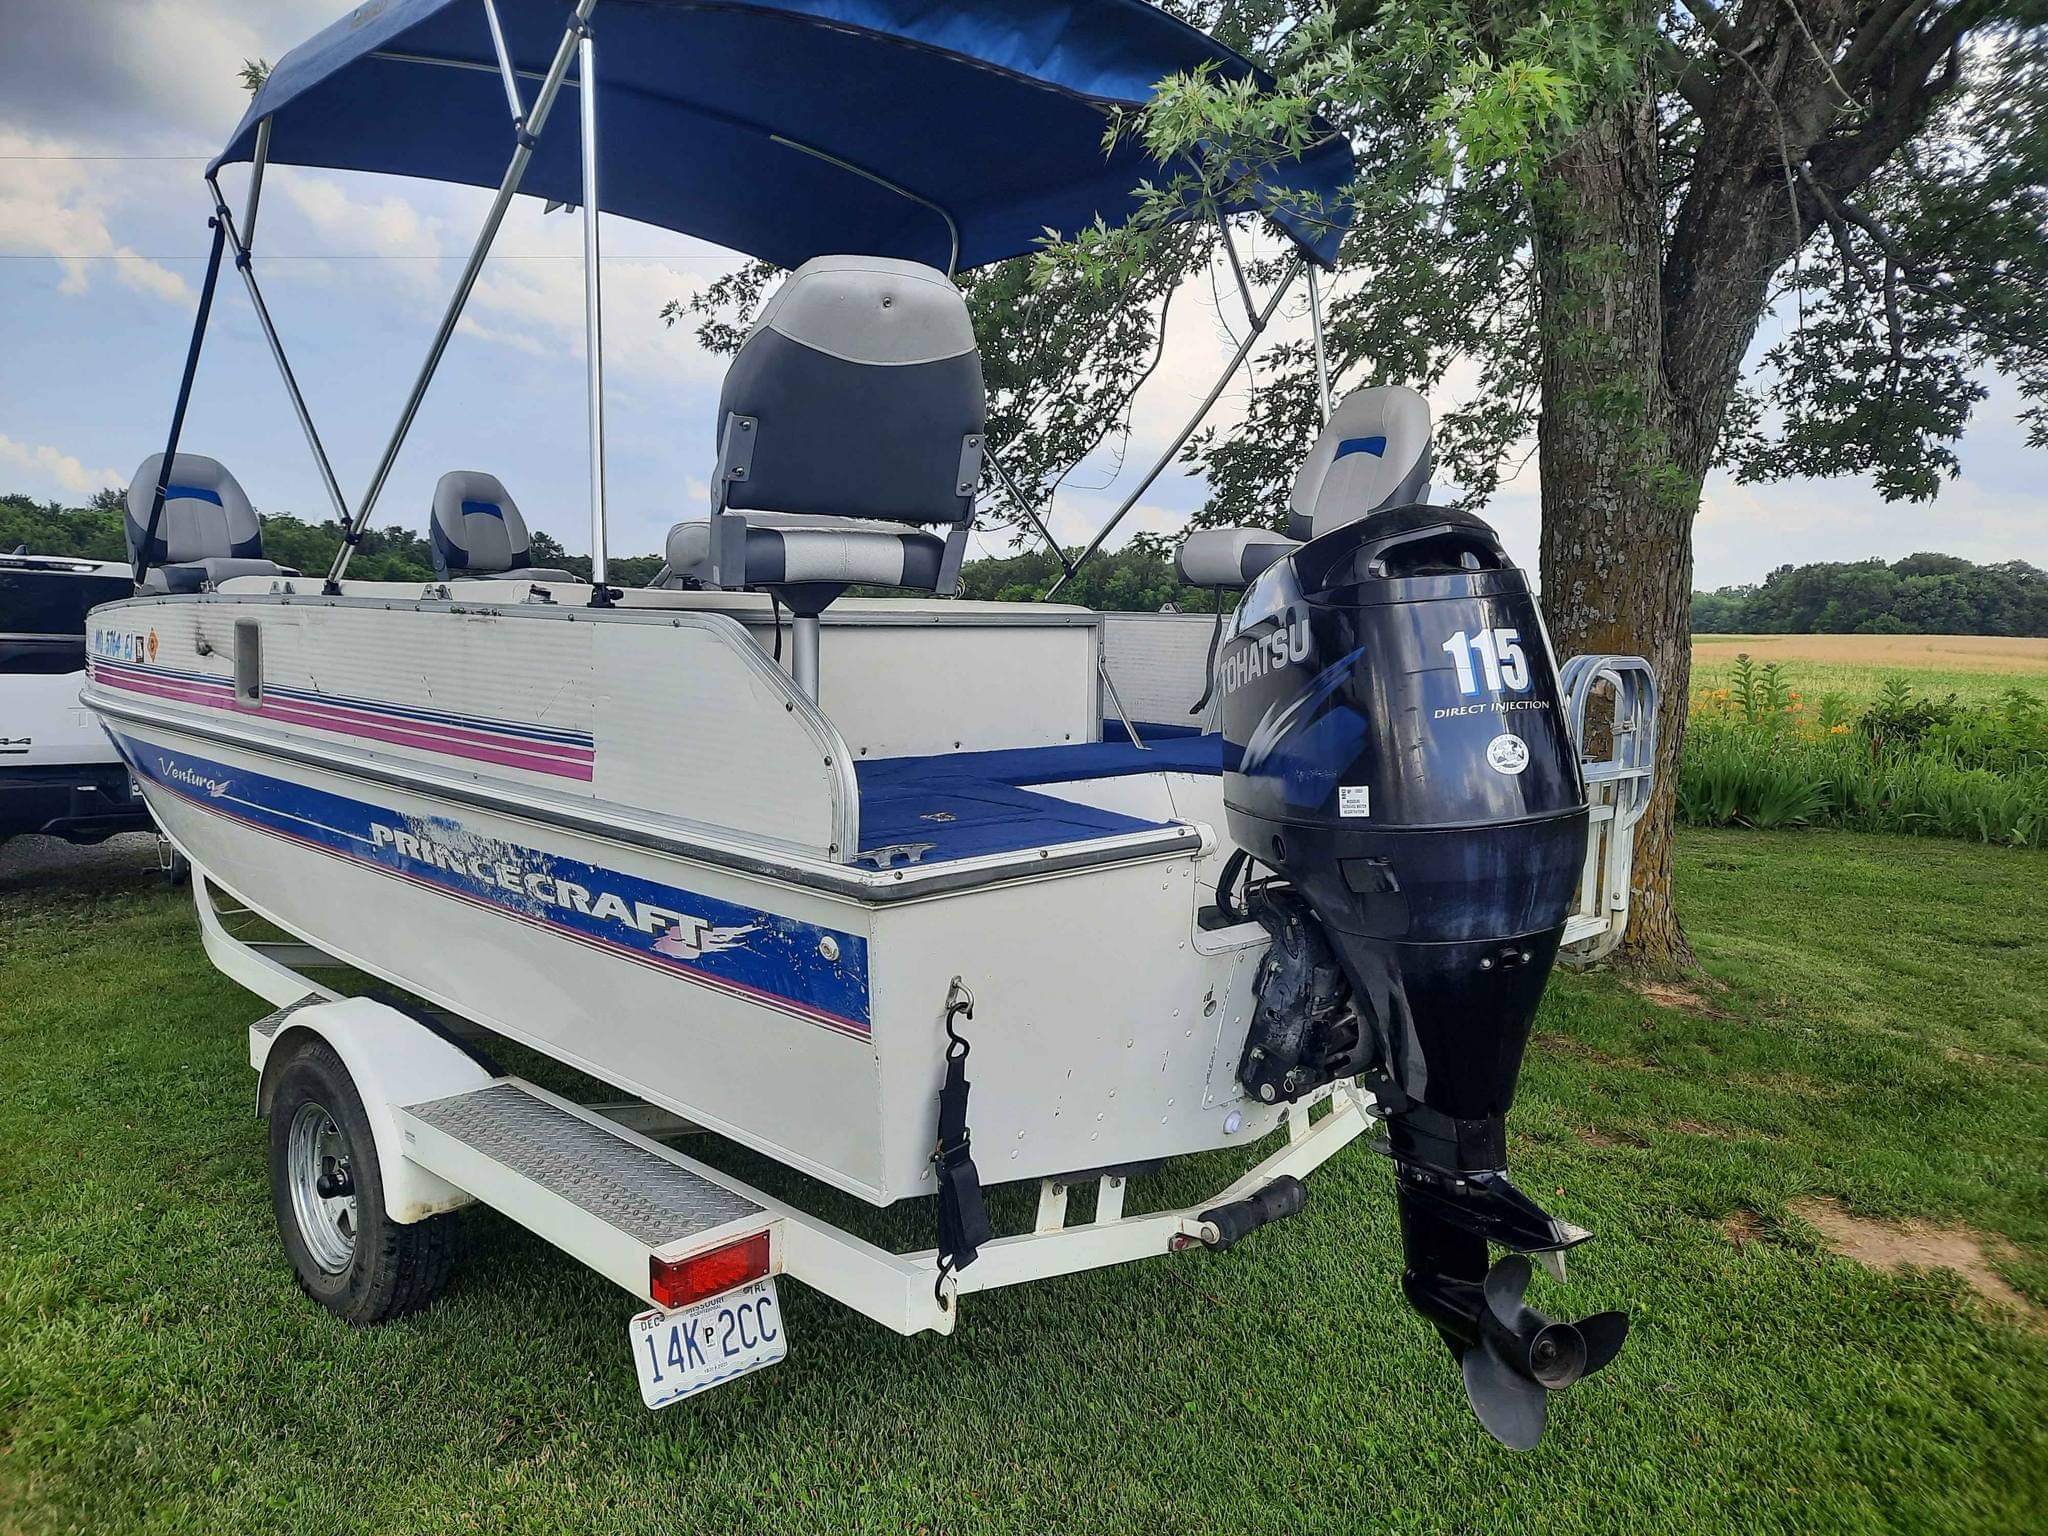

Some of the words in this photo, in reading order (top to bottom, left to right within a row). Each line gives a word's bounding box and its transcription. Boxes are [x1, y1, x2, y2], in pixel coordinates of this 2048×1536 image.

[1221, 619, 1311, 697] TOHATSU
[1442, 627, 1532, 696] 115
[1434, 704, 1487, 719] DIRECT
[1491, 699, 1550, 714] INJECTION
[158, 757, 216, 792] Ventura
[369, 822, 711, 949] PRINCECRAFT
[640, 1317, 660, 1331] DEC
[645, 1318, 706, 1383] 14K
[704, 1326, 714, 1344] P
[718, 1297, 777, 1358] 2CC
